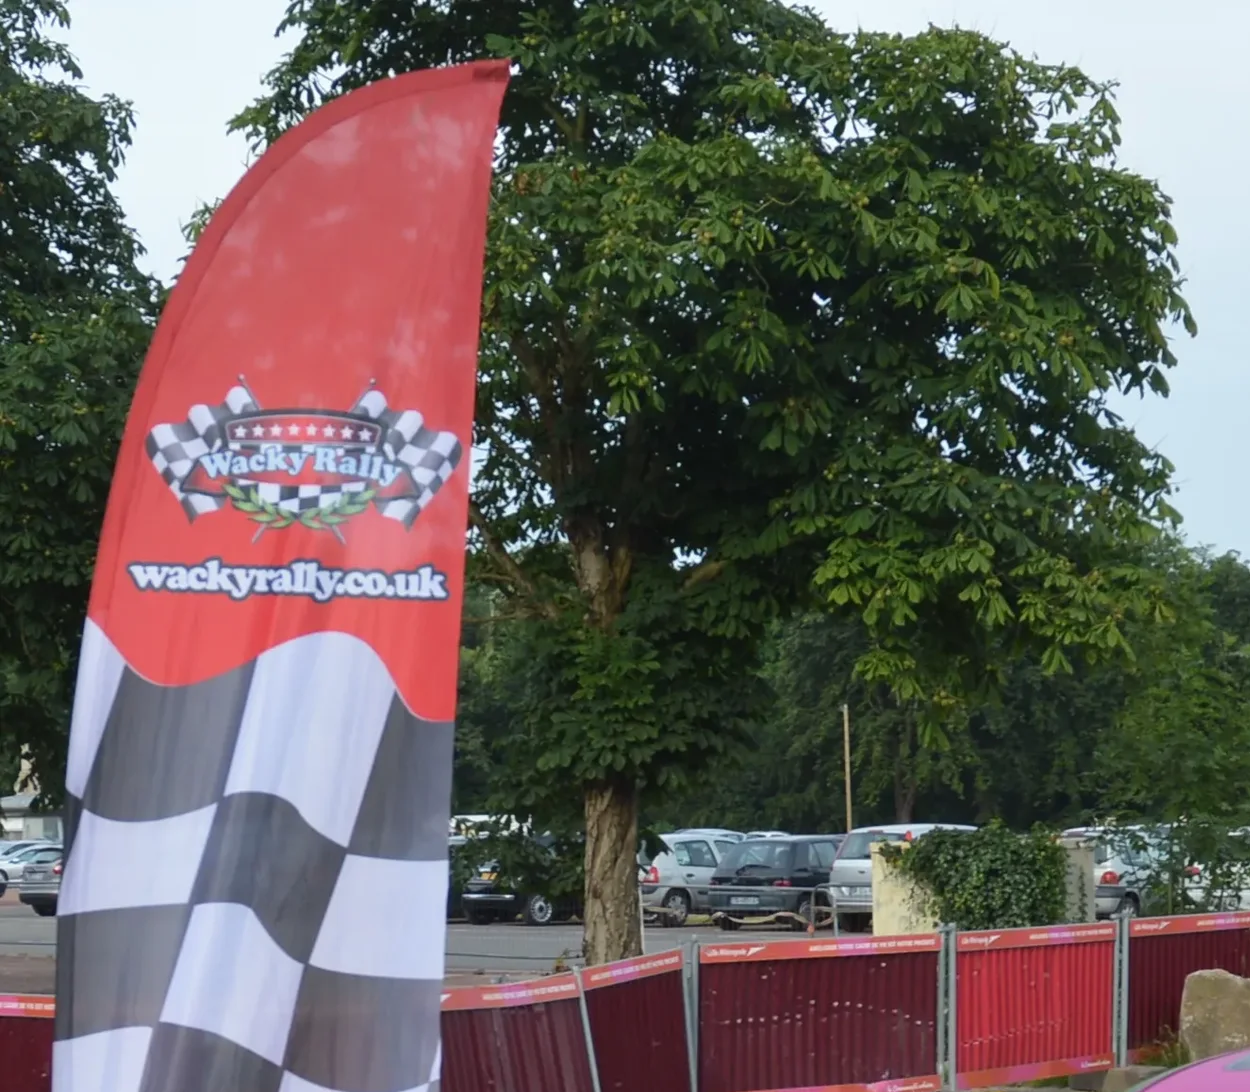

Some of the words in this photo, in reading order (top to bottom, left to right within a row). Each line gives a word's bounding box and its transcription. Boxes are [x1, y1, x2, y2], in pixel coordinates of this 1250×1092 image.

[201, 445, 308, 478] Wacky
[314, 447, 402, 486] Rally
[128, 559, 448, 600] wackyrally.co.uk
